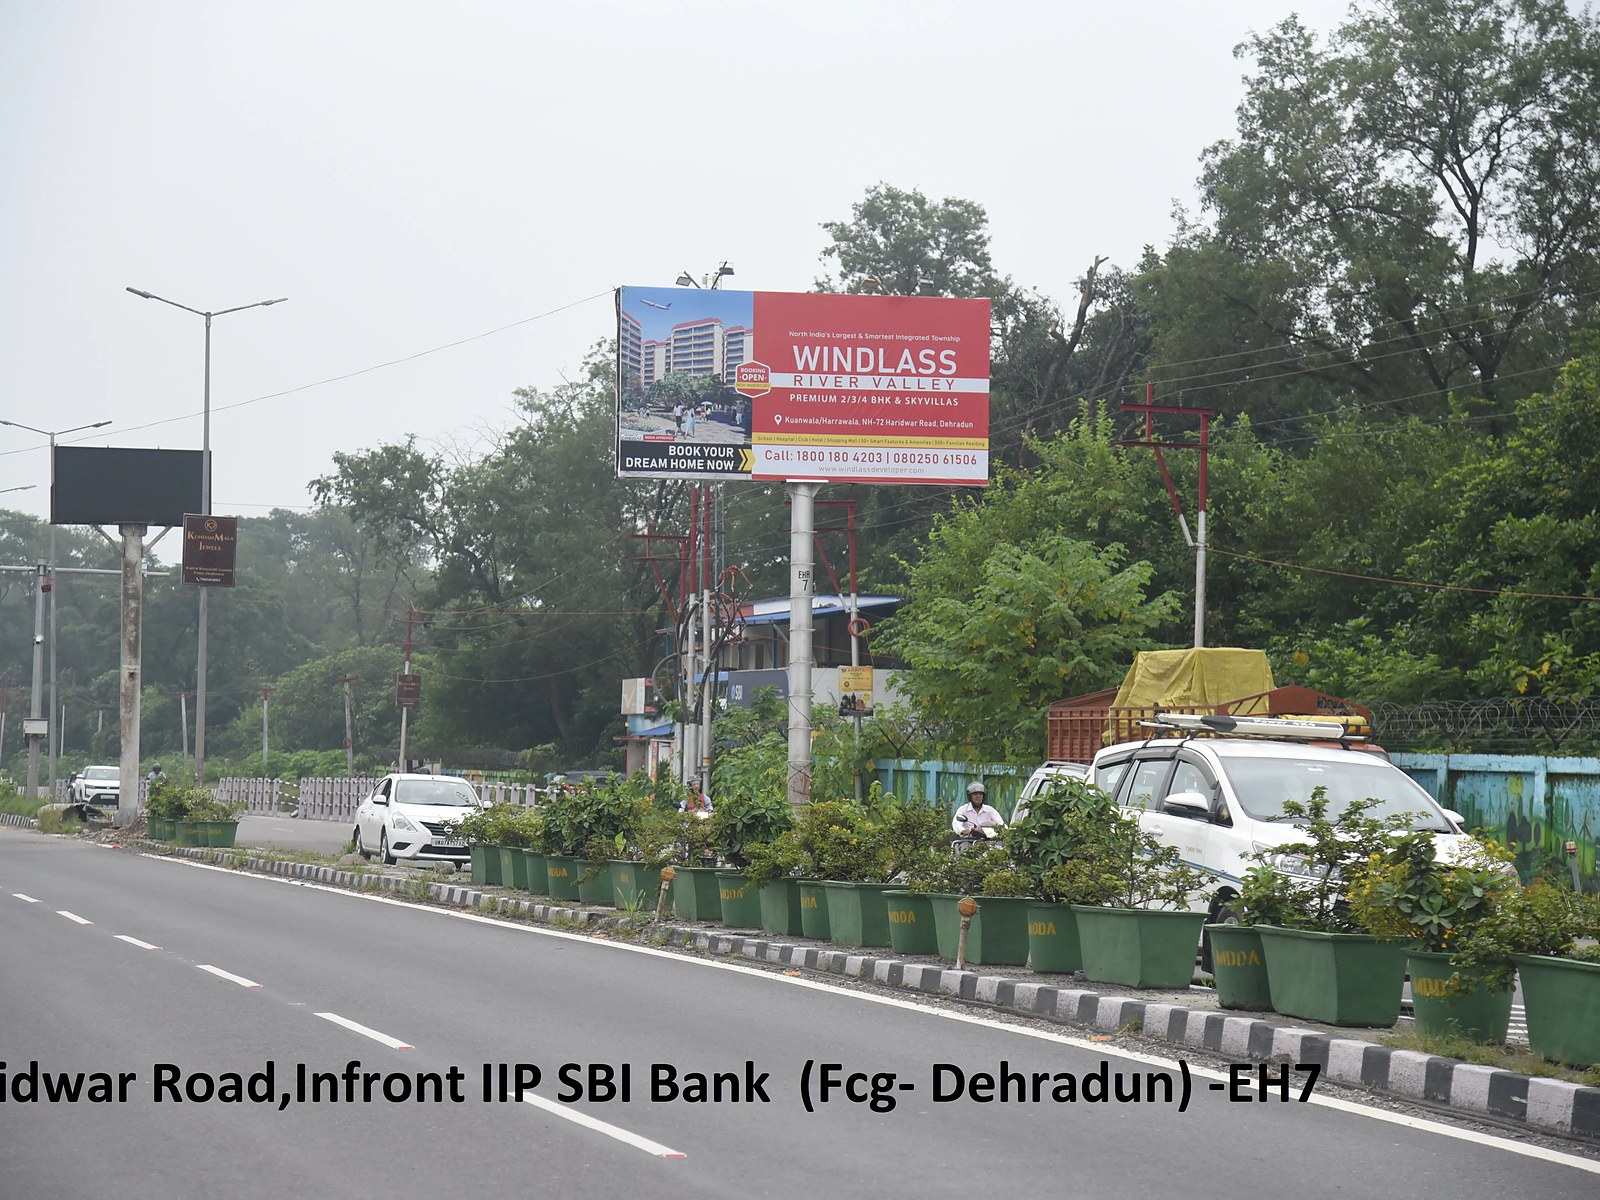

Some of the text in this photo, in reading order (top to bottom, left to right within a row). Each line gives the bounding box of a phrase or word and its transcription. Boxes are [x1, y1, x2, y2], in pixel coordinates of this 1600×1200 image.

[832, 332, 857, 340] Largest
[896, 334, 930, 342] Integrated
[931, 335, 961, 343] Township
[792, 345, 957, 375] WINDLASS
[741, 373, 765, 382] OPEN
[793, 374, 955, 391] RIVER VALLEY
[789, 393, 959, 406] PREMIUM 2/3/4 BHK & SKYVILLAS
[862, 418, 884, 426] NH-72
[885, 418, 918, 427] Haridwar
[940, 420, 974, 428] Dehradun
[668, 445, 734, 458] BOOK YOUR
[764, 449, 793, 461] Call:
[796, 450, 825, 462] 1800
[828, 451, 849, 462] 180
[852, 451, 883, 463] 4203
[893, 452, 939, 464] 080250
[943, 453, 977, 465] 61506
[625, 457, 735, 471] DREAM HOME NOW
[798, 570, 811, 580] EHR
[802, 579, 809, 592] 7
[735, 684, 743, 700] SBI
[1253, 718, 1287, 726] Power
[1215, 949, 1261, 967] MDDA
